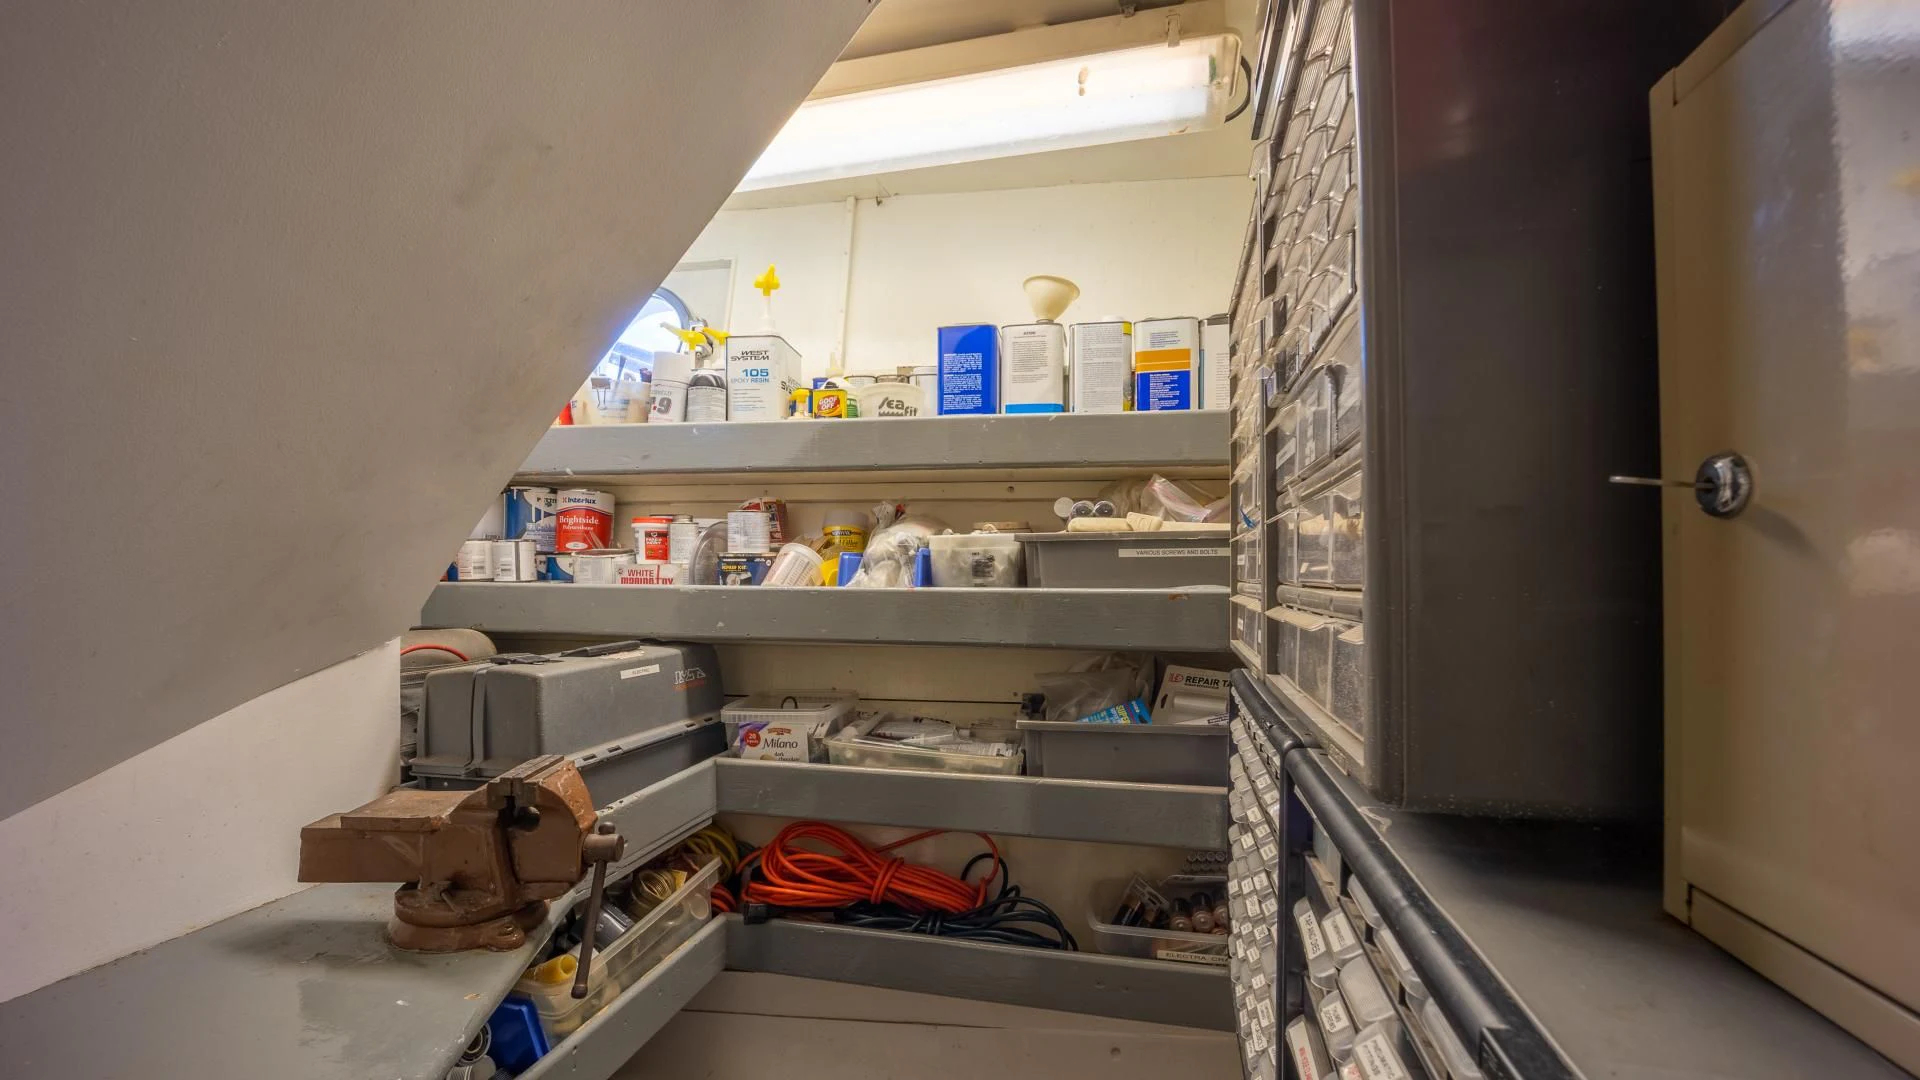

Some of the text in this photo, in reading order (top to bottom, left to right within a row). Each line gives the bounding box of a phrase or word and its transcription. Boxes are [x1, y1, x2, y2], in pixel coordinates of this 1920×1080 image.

[742, 368, 769, 377] 105
[819, 395, 838, 405] GOOF
[820, 402, 835, 410] OFF
[559, 515, 600, 525] Brightside
[627, 569, 654, 577] WHITE
[1184, 675, 1220, 687] REPAIR
[762, 737, 798, 749] Milano
